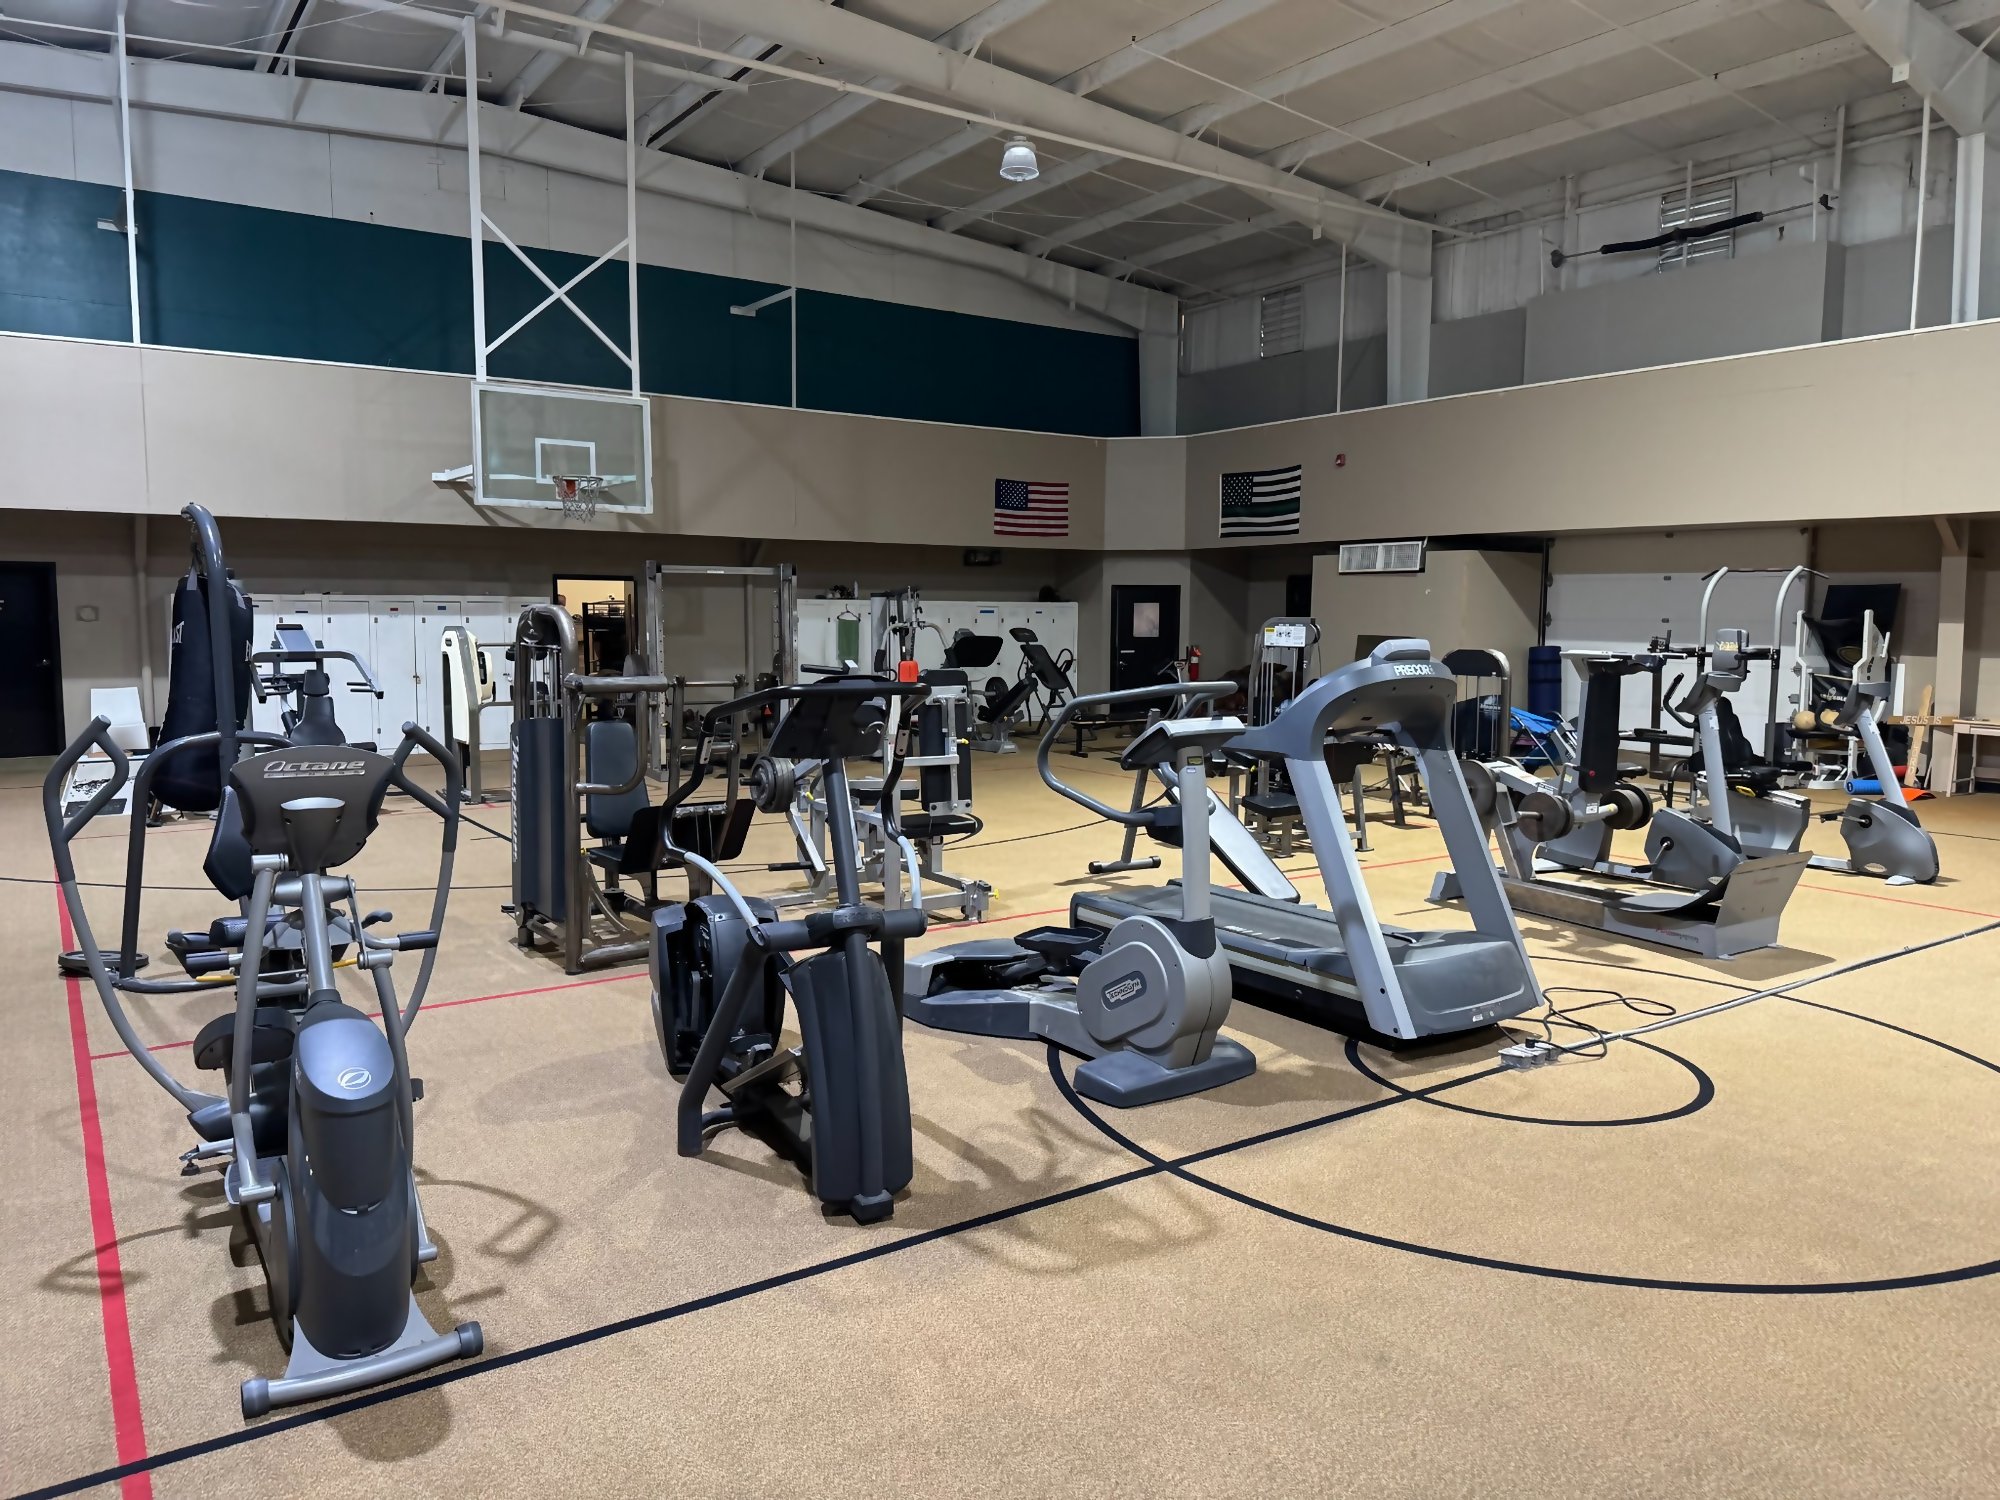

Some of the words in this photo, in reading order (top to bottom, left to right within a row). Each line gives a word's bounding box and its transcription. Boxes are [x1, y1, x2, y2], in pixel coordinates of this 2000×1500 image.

[1394, 664, 1431, 676] PRECOR
[1900, 715, 1929, 725] JESUS
[1933, 715, 1943, 725] IS
[264, 760, 365, 772] Octane
